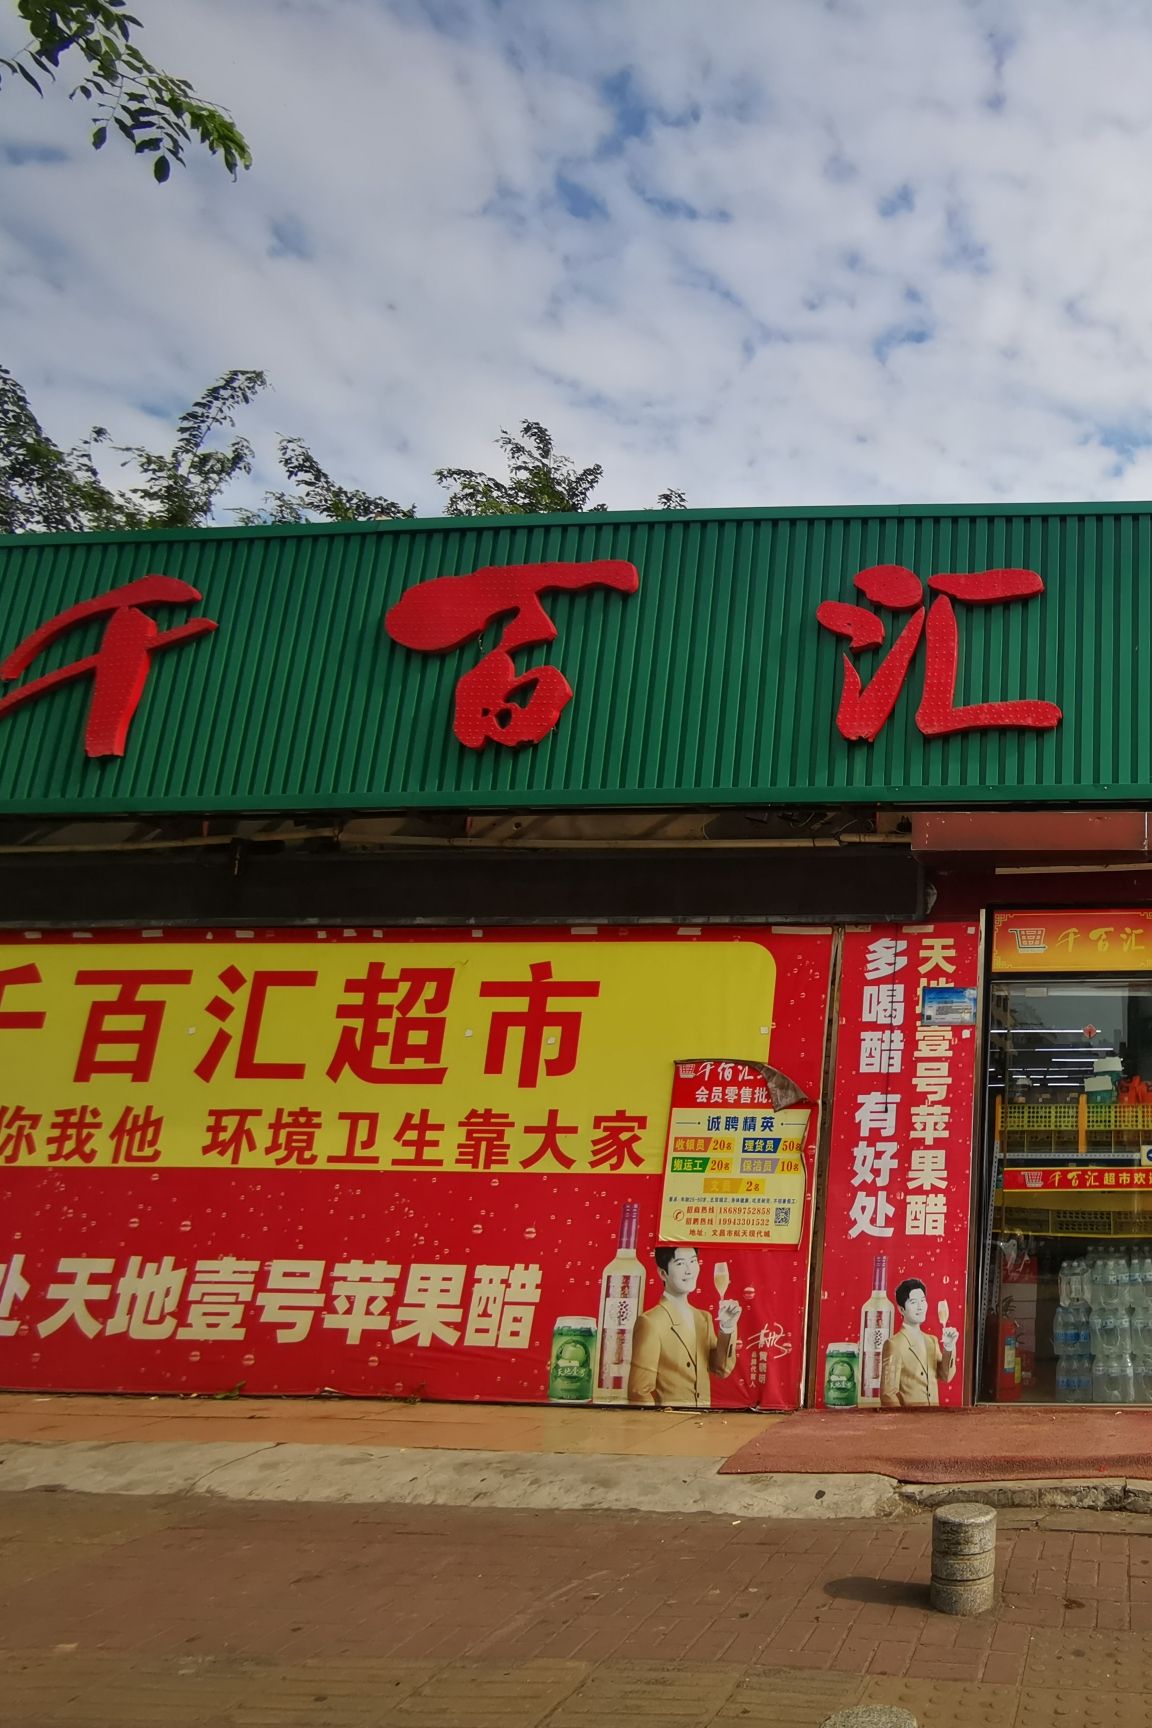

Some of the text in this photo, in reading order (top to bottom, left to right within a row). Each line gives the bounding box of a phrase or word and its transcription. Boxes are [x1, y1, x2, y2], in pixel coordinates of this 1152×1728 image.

[1054, 926, 1147, 954] 千百汇
[695, 1061, 763, 1081] 千佰汇
[695, 1086, 772, 1104] 会员零售批
[848, 937, 908, 1239] 多喝醋 有好处
[904, 937, 957, 1237] 天壹号苹果醋
[707, 1115, 776, 1132] 诚聘精英
[201, 1106, 649, 1172] 环境卫生靠大家
[745, 1180, 760, 1193] 2名
